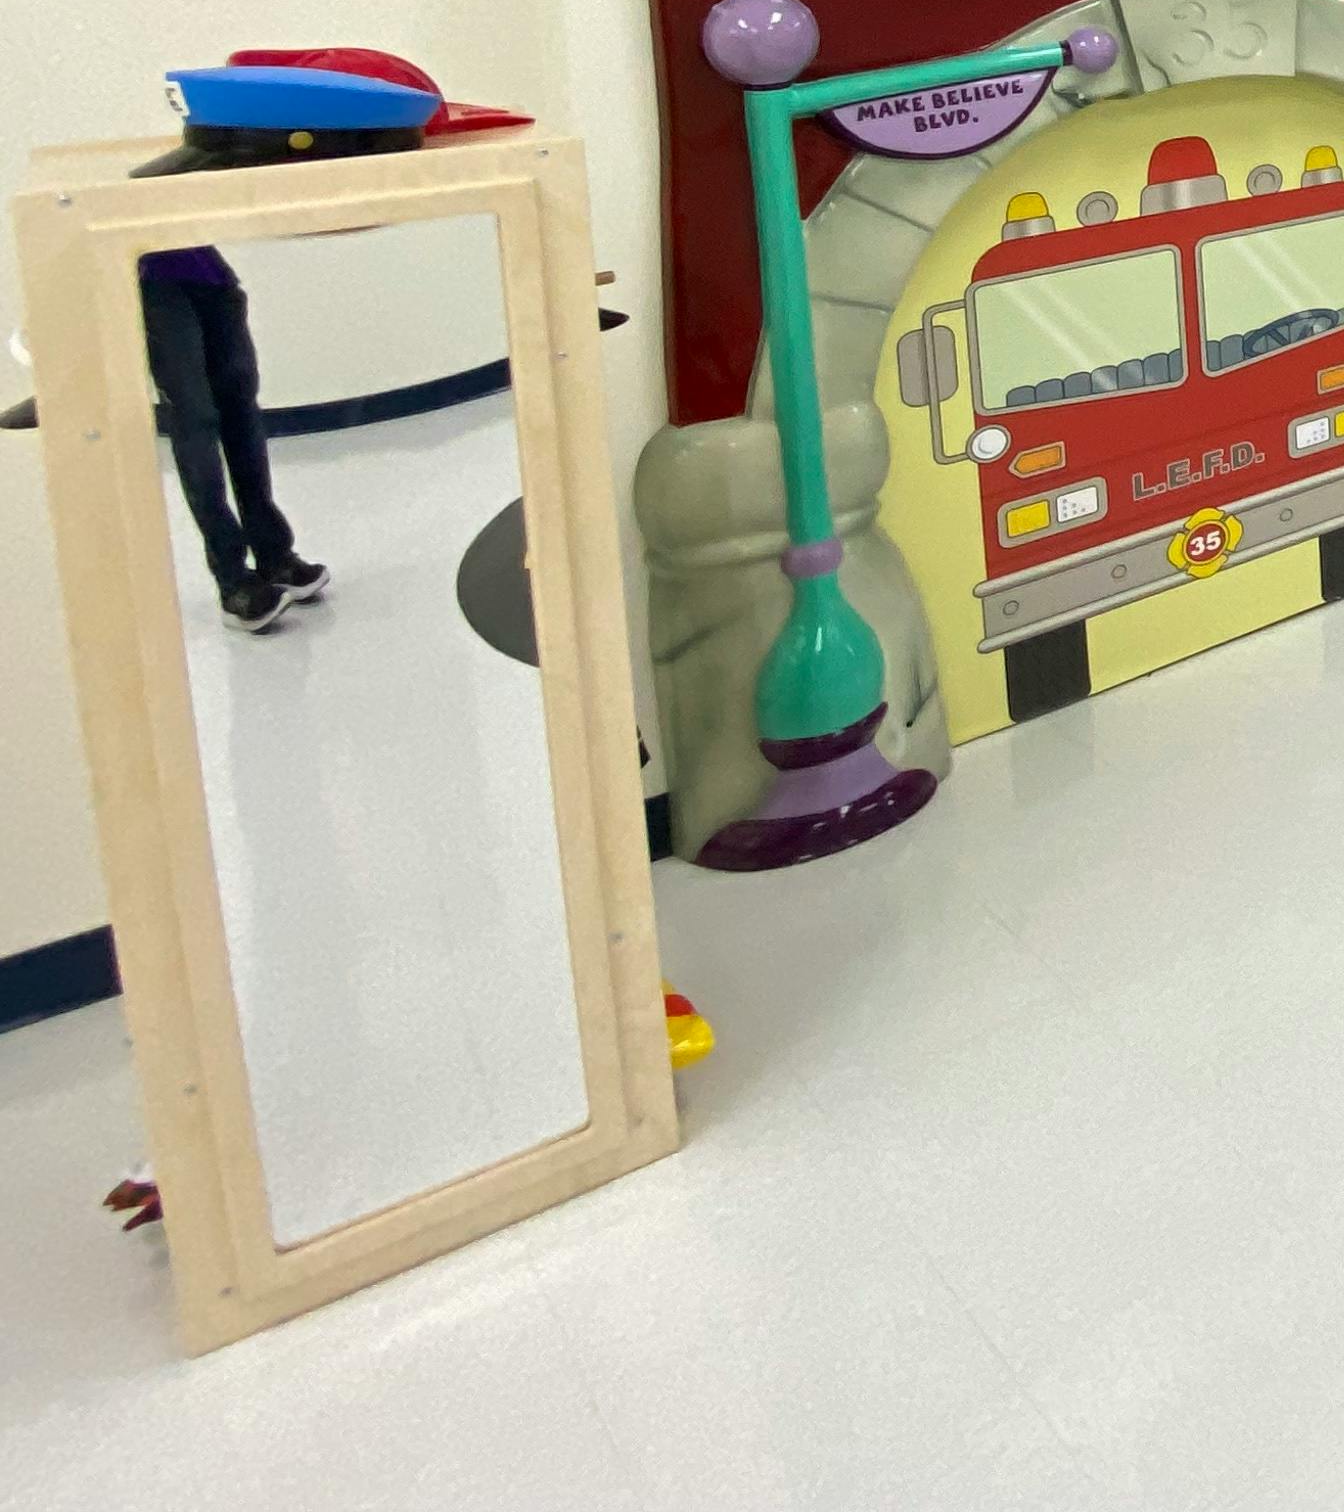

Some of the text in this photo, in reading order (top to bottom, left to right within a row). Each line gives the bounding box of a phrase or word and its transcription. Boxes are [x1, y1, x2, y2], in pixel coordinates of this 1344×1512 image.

[857, 79, 1024, 122] MAKE BELIEVE
[914, 109, 979, 133] BLVD.
[1132, 441, 1265, 501] L.E.F.D.
[1190, 530, 1221, 556] 35
